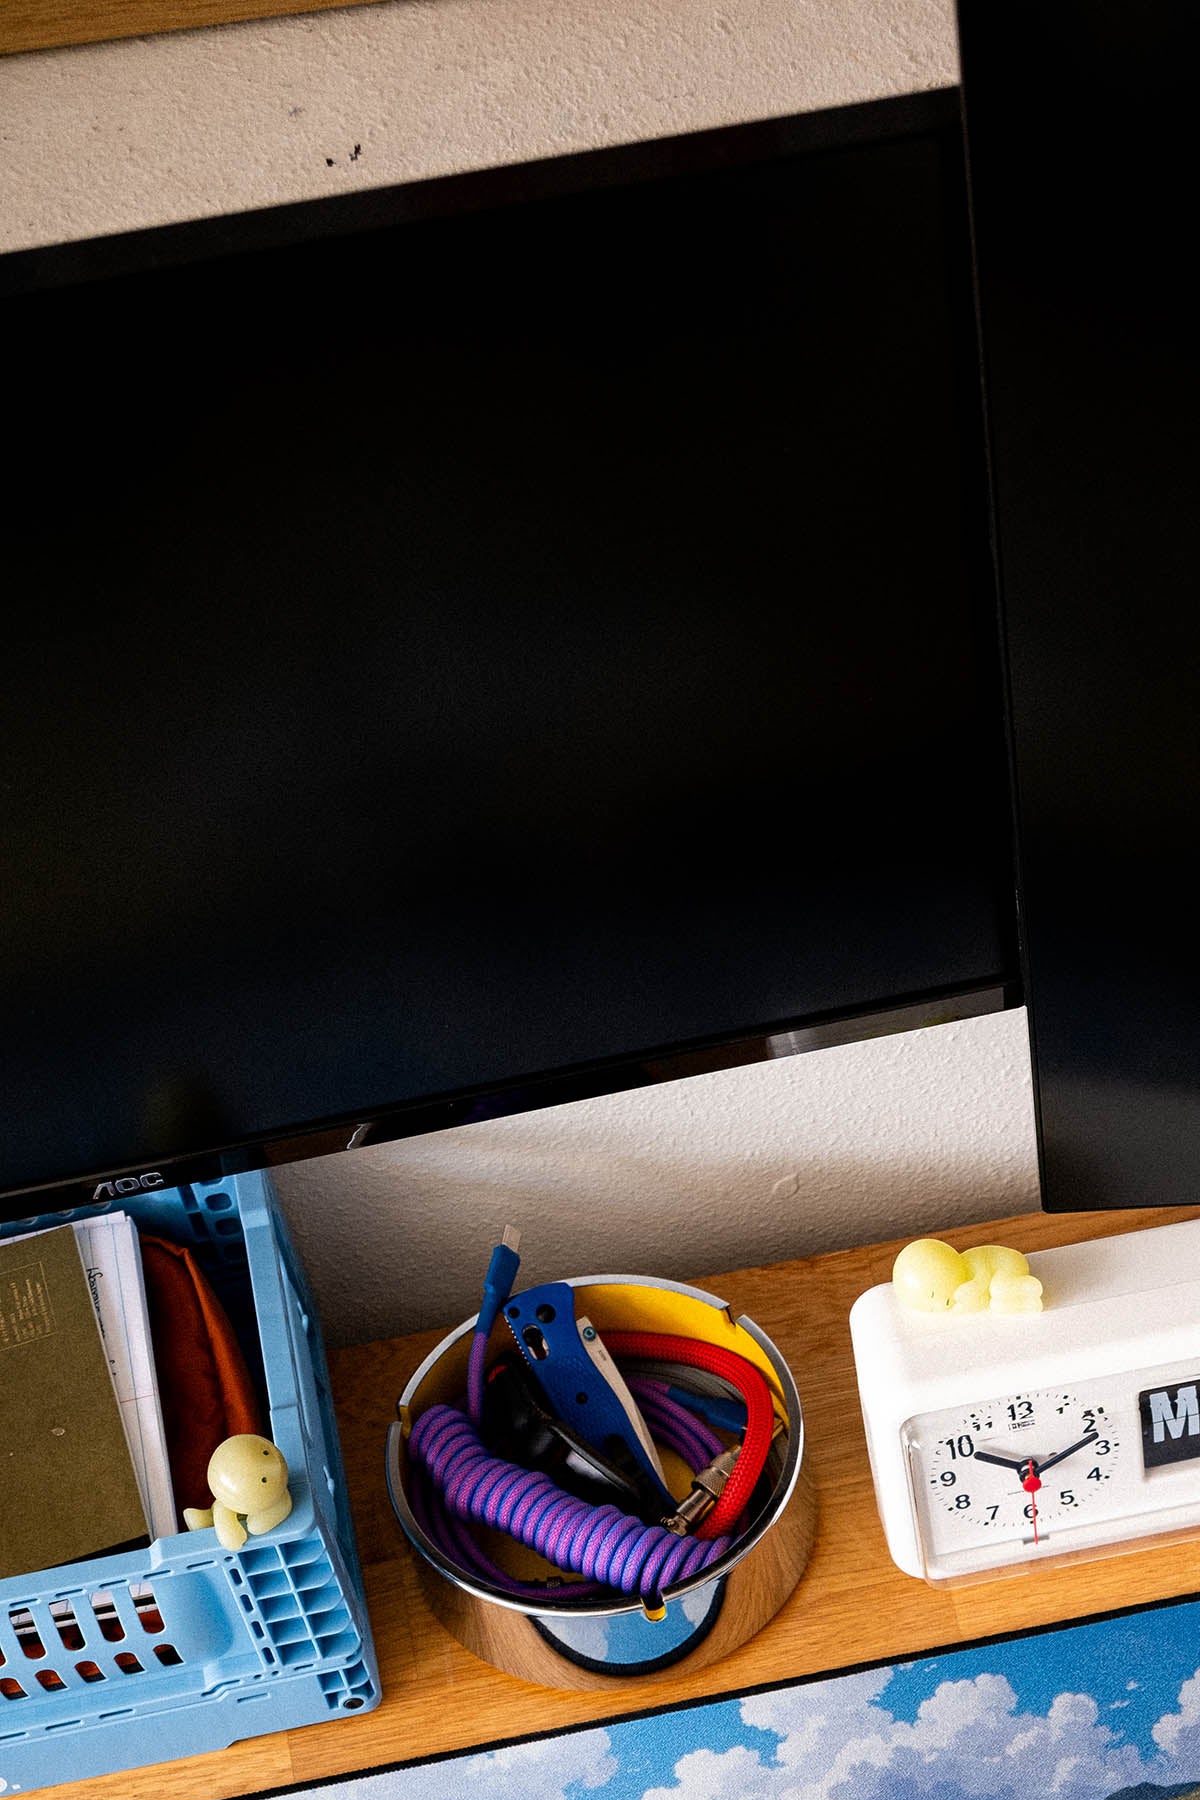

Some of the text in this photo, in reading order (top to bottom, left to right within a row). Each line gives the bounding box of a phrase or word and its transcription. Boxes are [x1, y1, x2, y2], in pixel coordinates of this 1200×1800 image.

[93, 1172, 164, 1200] AOC
[946, 1434, 975, 1460] 10
[1095, 1440, 1111, 1456] 3
[940, 1471, 957, 1487] 9
[1086, 1467, 1103, 1482] 4
[955, 1494, 971, 1510] 8
[1060, 1490, 1075, 1505] 5
[986, 1505, 1000, 1521] 7
[1023, 1504, 1039, 1519] 6
